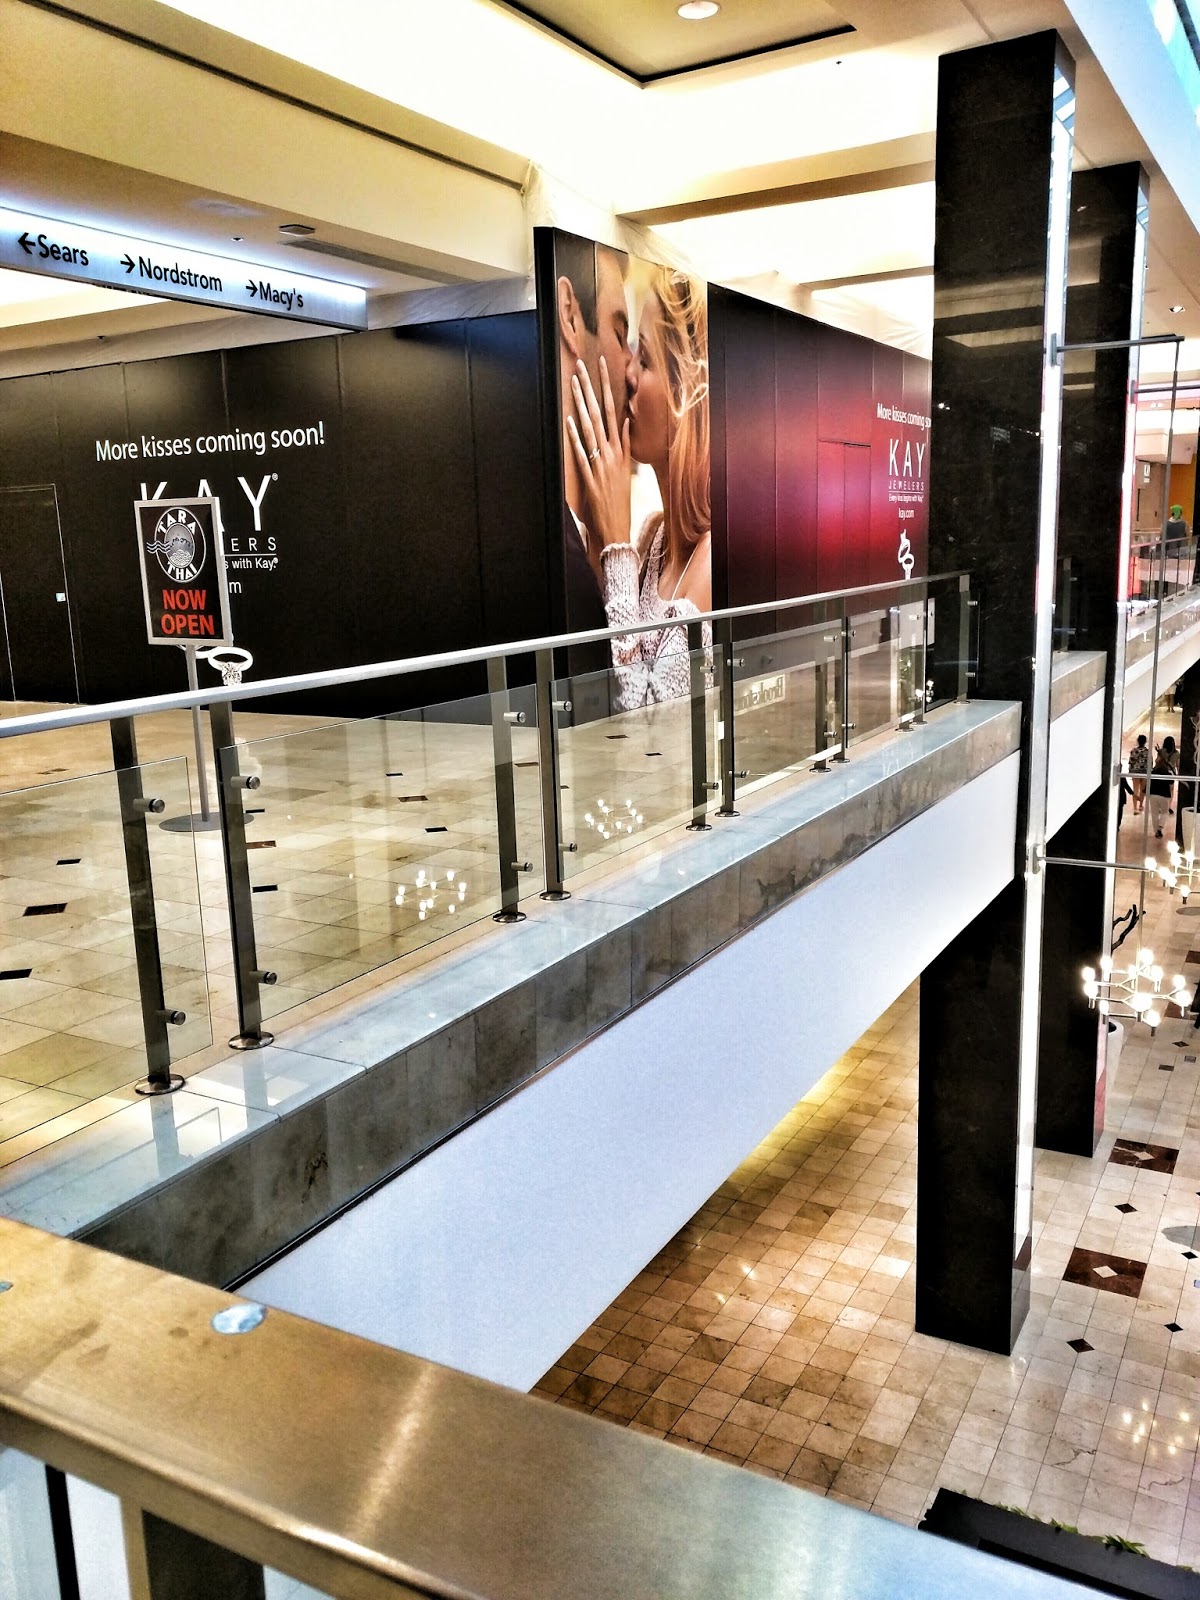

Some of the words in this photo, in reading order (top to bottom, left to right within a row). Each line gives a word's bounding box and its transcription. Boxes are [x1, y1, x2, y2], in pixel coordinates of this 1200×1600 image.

[38, 233, 90, 266] Sears
[139, 256, 223, 292] Nordstrom
[260, 281, 304, 310] Macy's
[877, 402, 892, 421] More
[95, 440, 139, 461] More
[141, 435, 192, 458] kisses
[196, 428, 266, 455] coming
[271, 421, 325, 449] soon!
[888, 438, 925, 478] KAY
[888, 480, 925, 491] JEWELERS
[157, 509, 197, 536] TARA
[166, 561, 198, 581] THAI
[232, 558, 253, 569] with
[162, 589, 207, 611] NOW
[160, 613, 215, 636] OPEN
